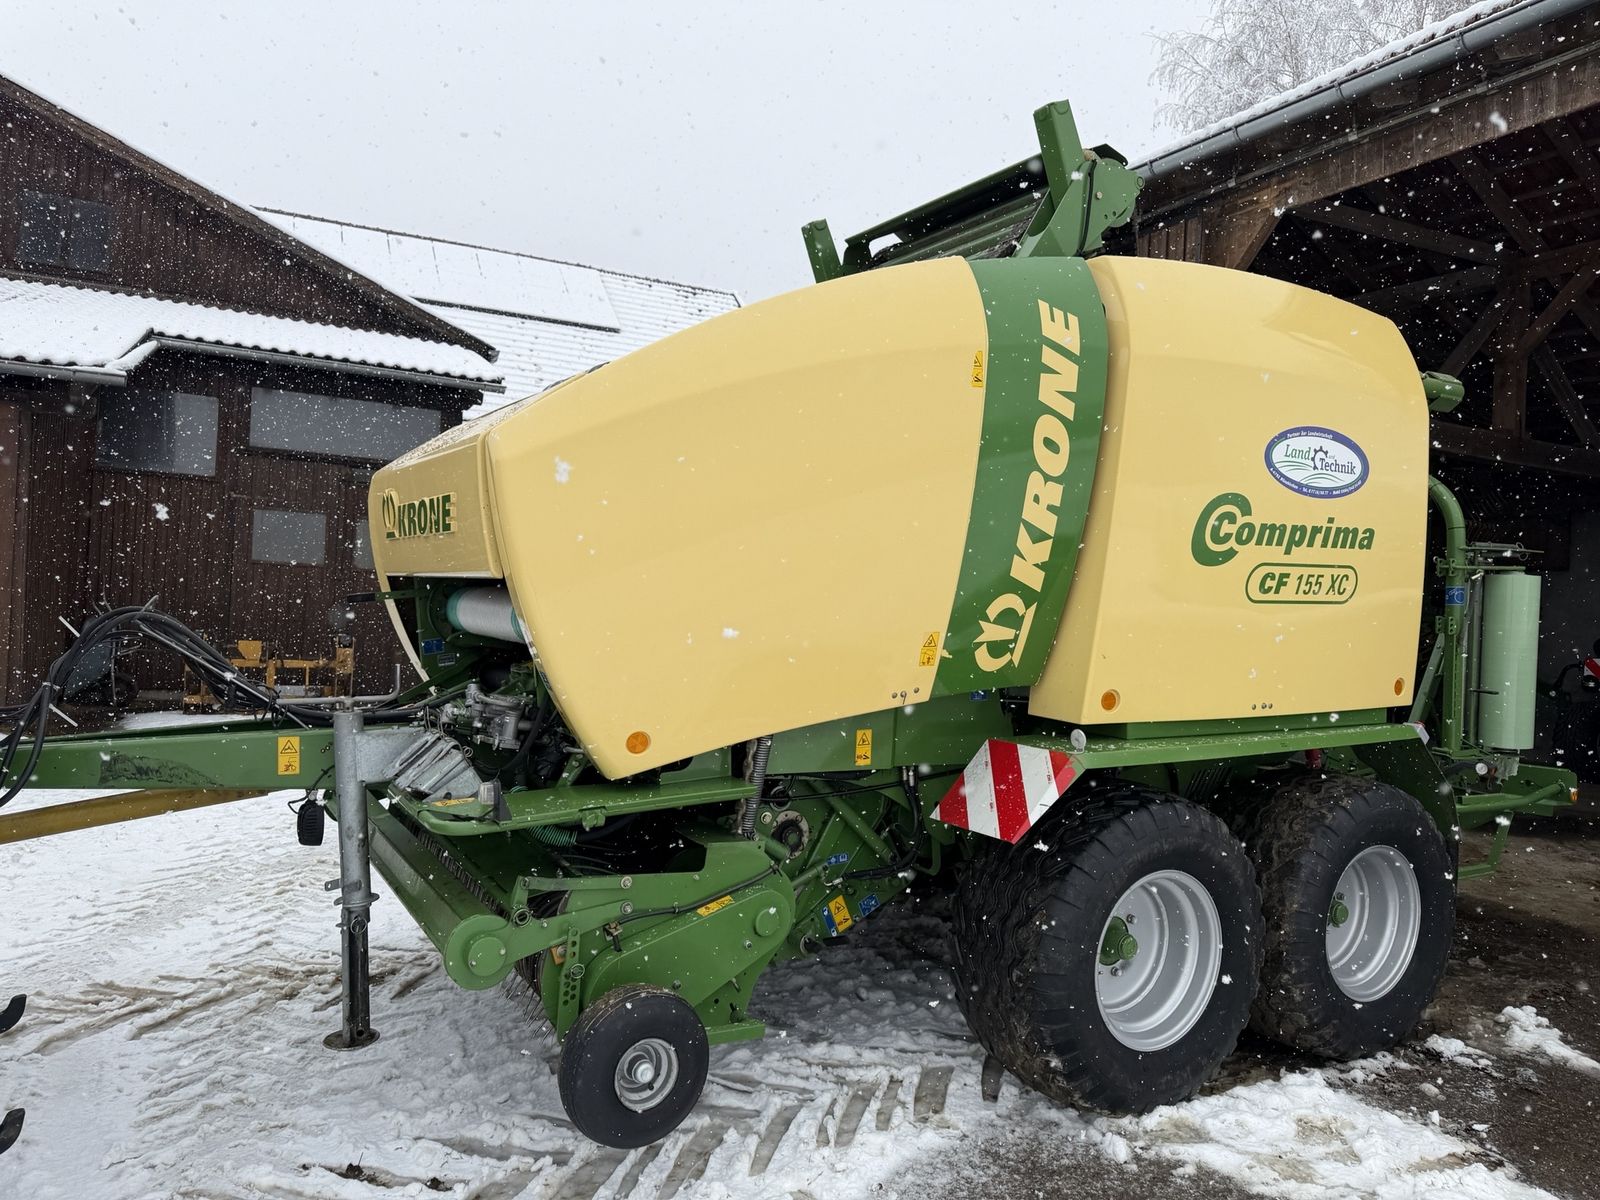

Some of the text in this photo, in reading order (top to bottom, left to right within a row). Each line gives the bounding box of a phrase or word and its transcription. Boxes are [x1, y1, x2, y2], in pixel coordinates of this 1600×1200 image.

[1010, 299, 1081, 592] KRONE
[1284, 444, 1312, 461] Land
[1319, 457, 1356, 475] Technik
[397, 494, 452, 538] KRONE
[1191, 492, 1375, 567] Comprima
[1258, 572, 1350, 596] CF 155 XC
